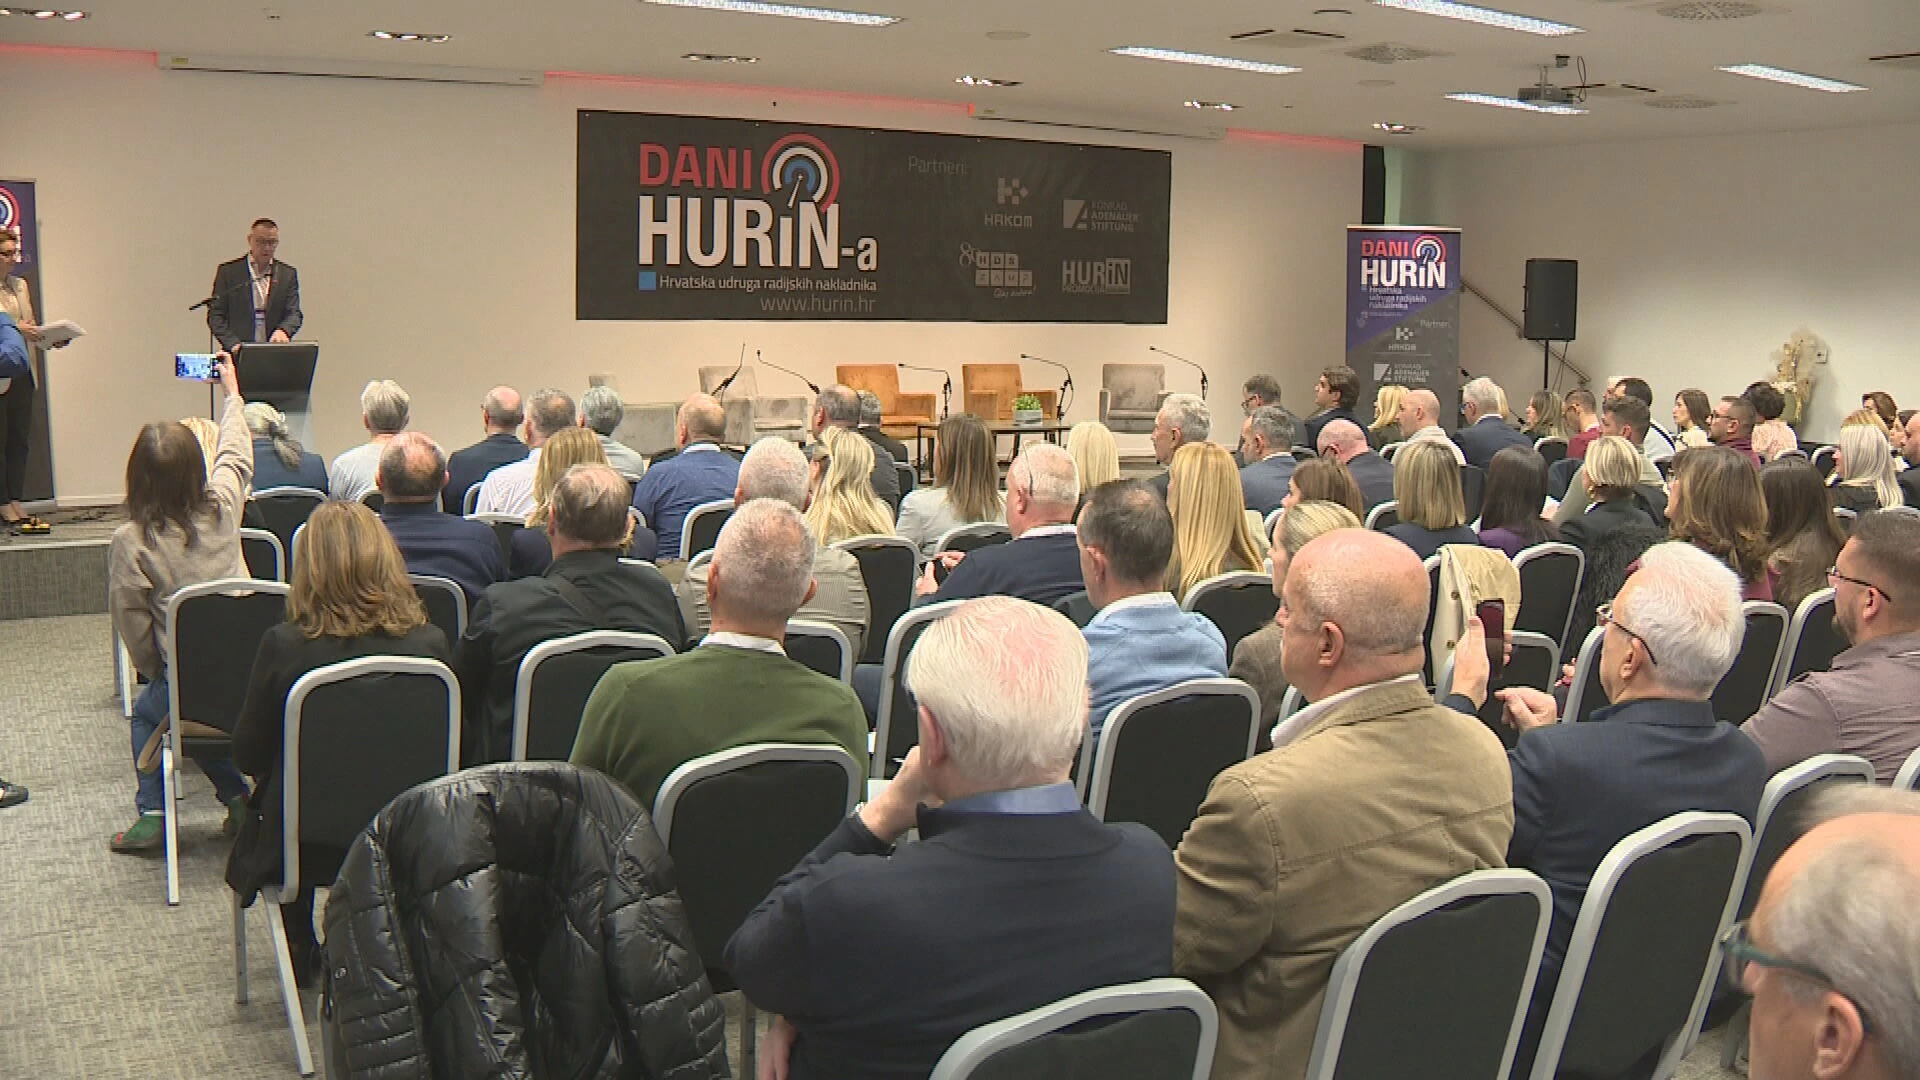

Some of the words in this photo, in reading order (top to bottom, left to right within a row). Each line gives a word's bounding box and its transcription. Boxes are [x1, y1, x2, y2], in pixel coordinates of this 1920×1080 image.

[639, 143, 752, 190] DANI
[1091, 200, 1128, 210] KONRAD
[1091, 211, 1139, 222] ADENAUER
[1091, 220, 1134, 232] STIFTUNG
[1361, 239, 1408, 257] DANI
[659, 275, 715, 290] Hrvatska
[719, 276, 760, 292] udruga
[764, 276, 812, 293] radijskih
[815, 278, 877, 292] nakladnika
[760, 294, 874, 313] www.hurin.hr
